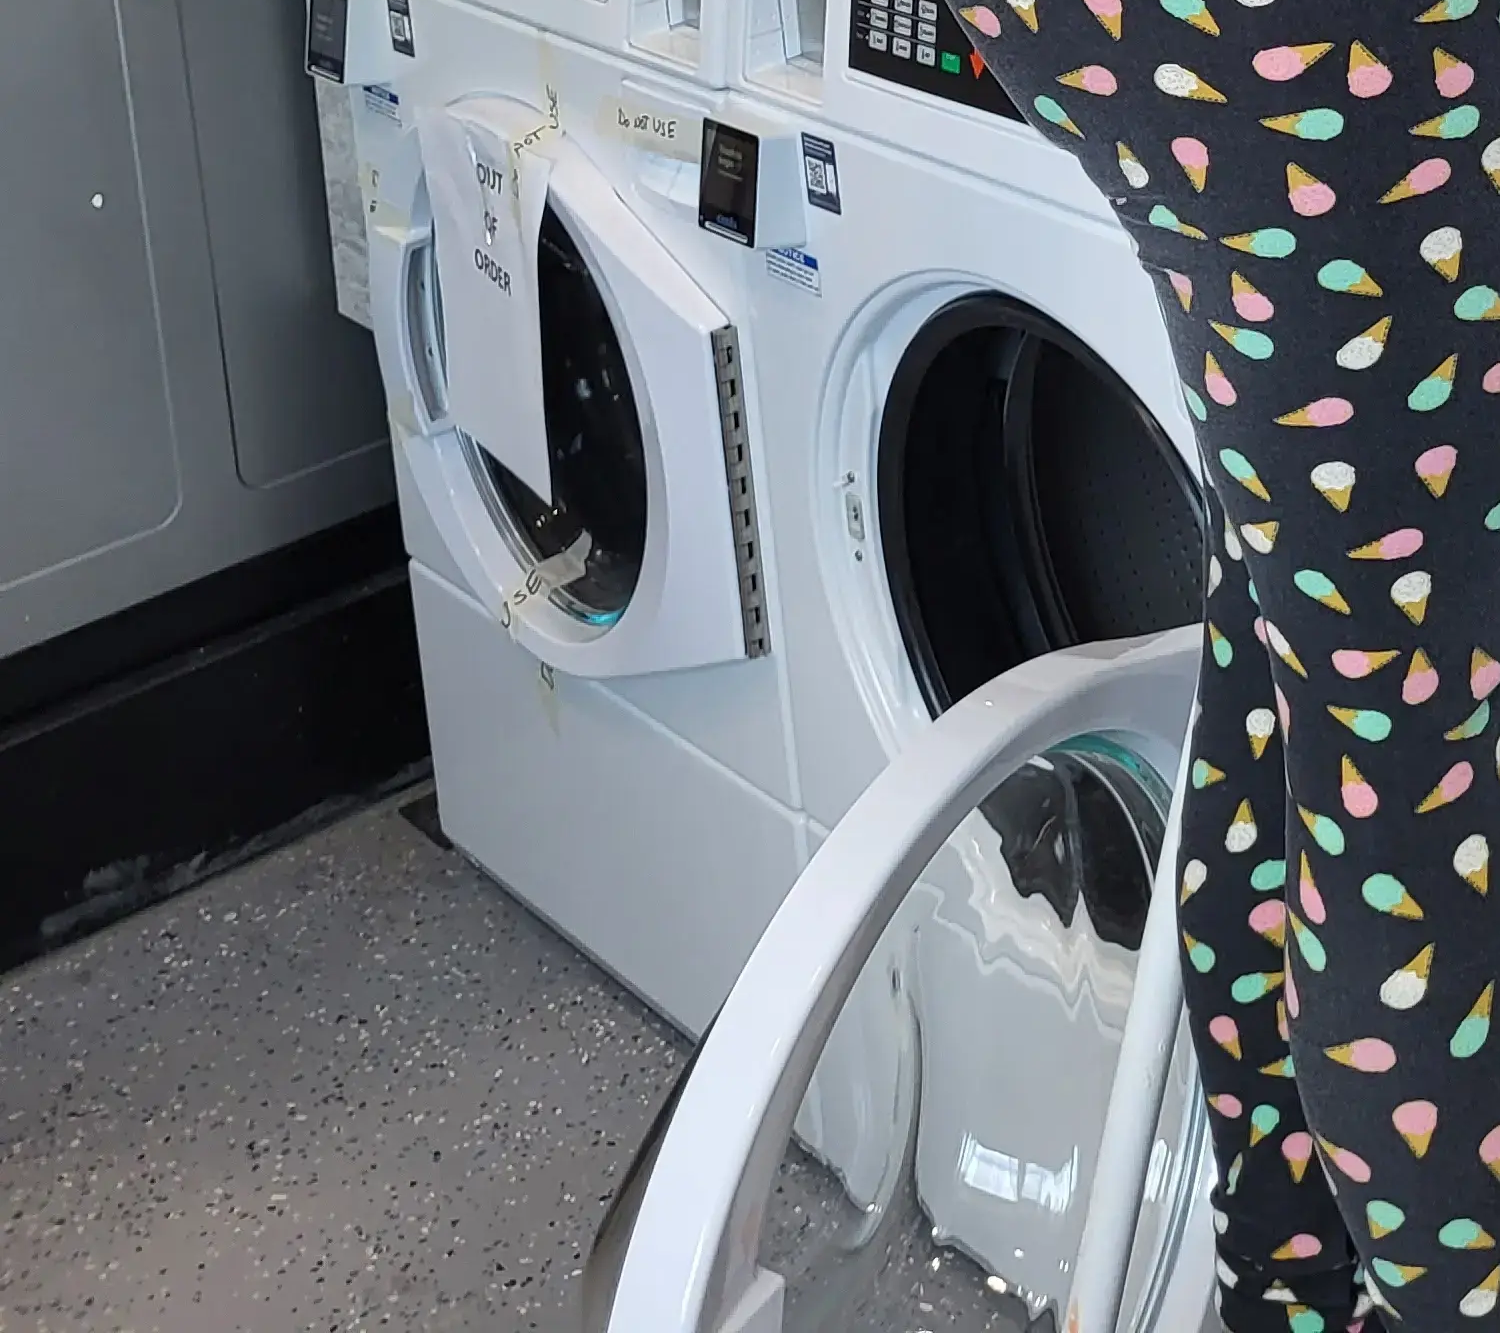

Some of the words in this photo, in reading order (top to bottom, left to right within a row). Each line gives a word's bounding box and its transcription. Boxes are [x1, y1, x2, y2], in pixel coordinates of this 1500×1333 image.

[652, 117, 677, 139] USE
[476, 163, 504, 194] OUT
[474, 248, 512, 297] ORDER
